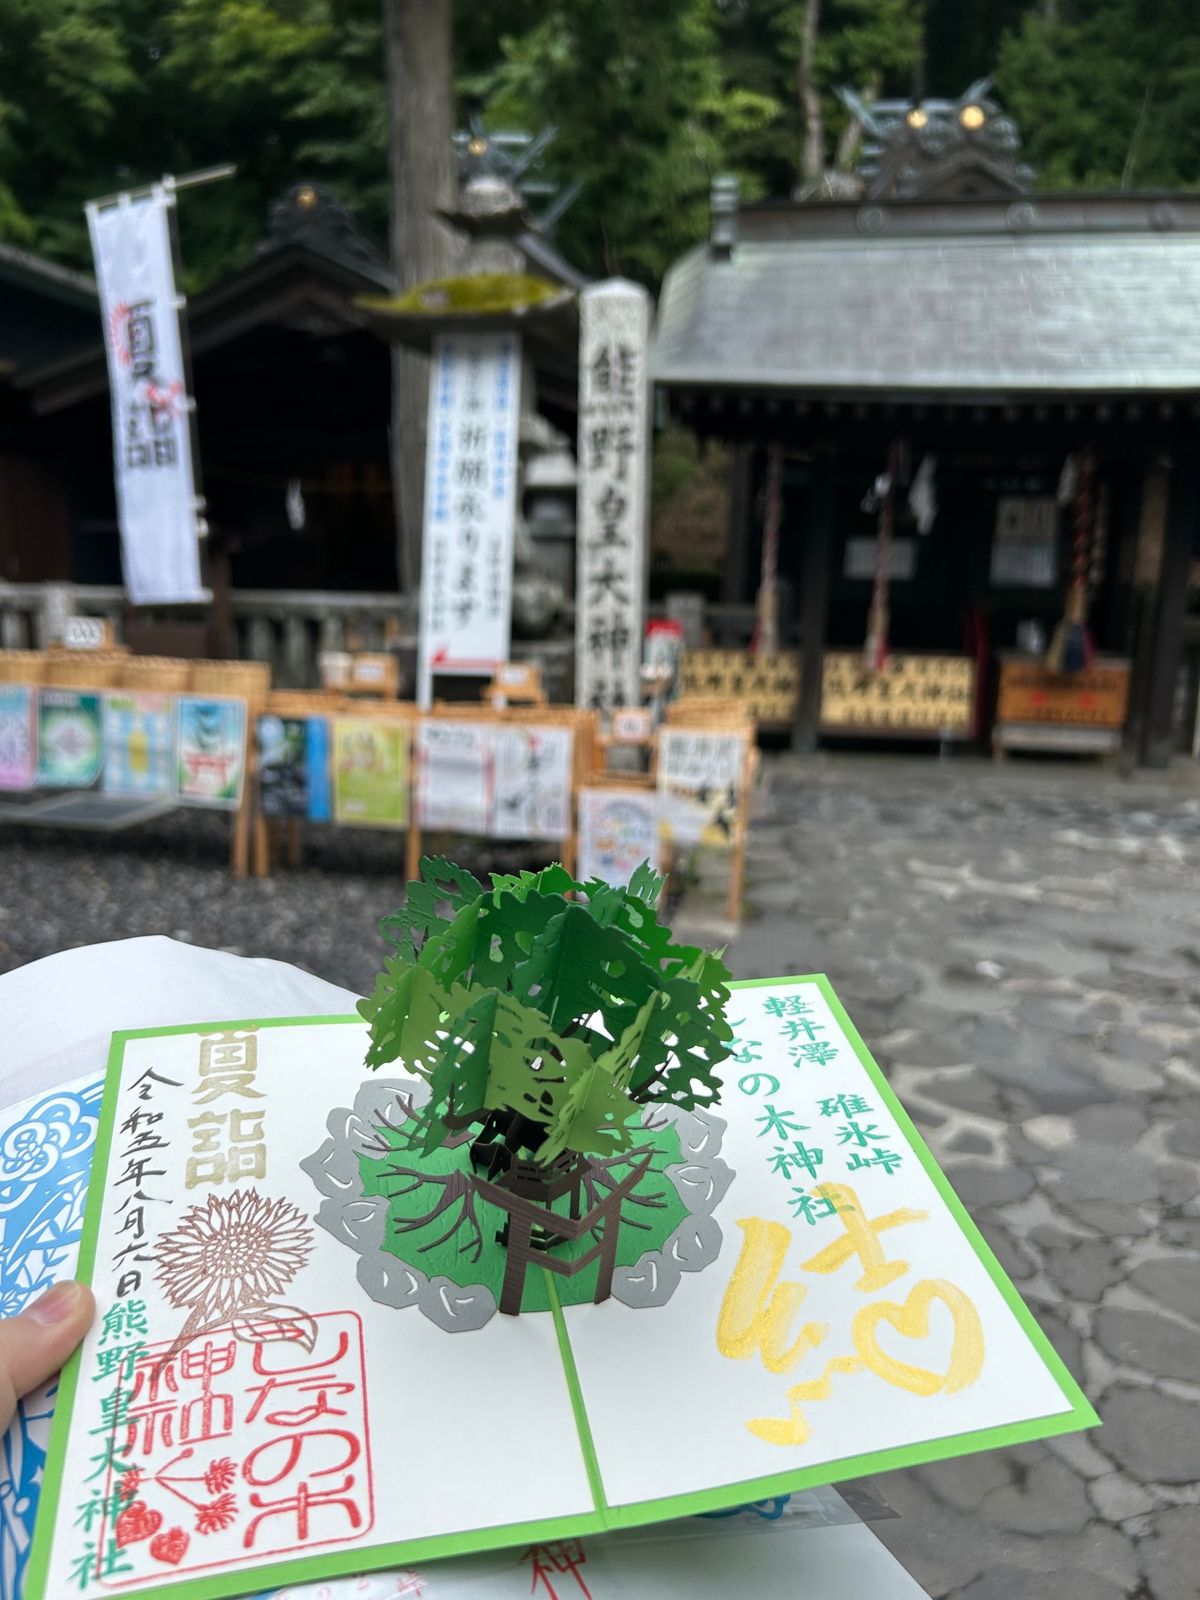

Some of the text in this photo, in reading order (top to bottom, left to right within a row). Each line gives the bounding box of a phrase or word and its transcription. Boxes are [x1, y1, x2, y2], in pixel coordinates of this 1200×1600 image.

[114, 1067, 186, 1299] 令和五年八月六日
[184, 1027, 267, 1190] 夏詣
[722, 1017, 856, 1226] なの木神社
[816, 1094, 904, 1176] 碓氷峠
[66, 1298, 150, 1590] 熊野皇大神社
